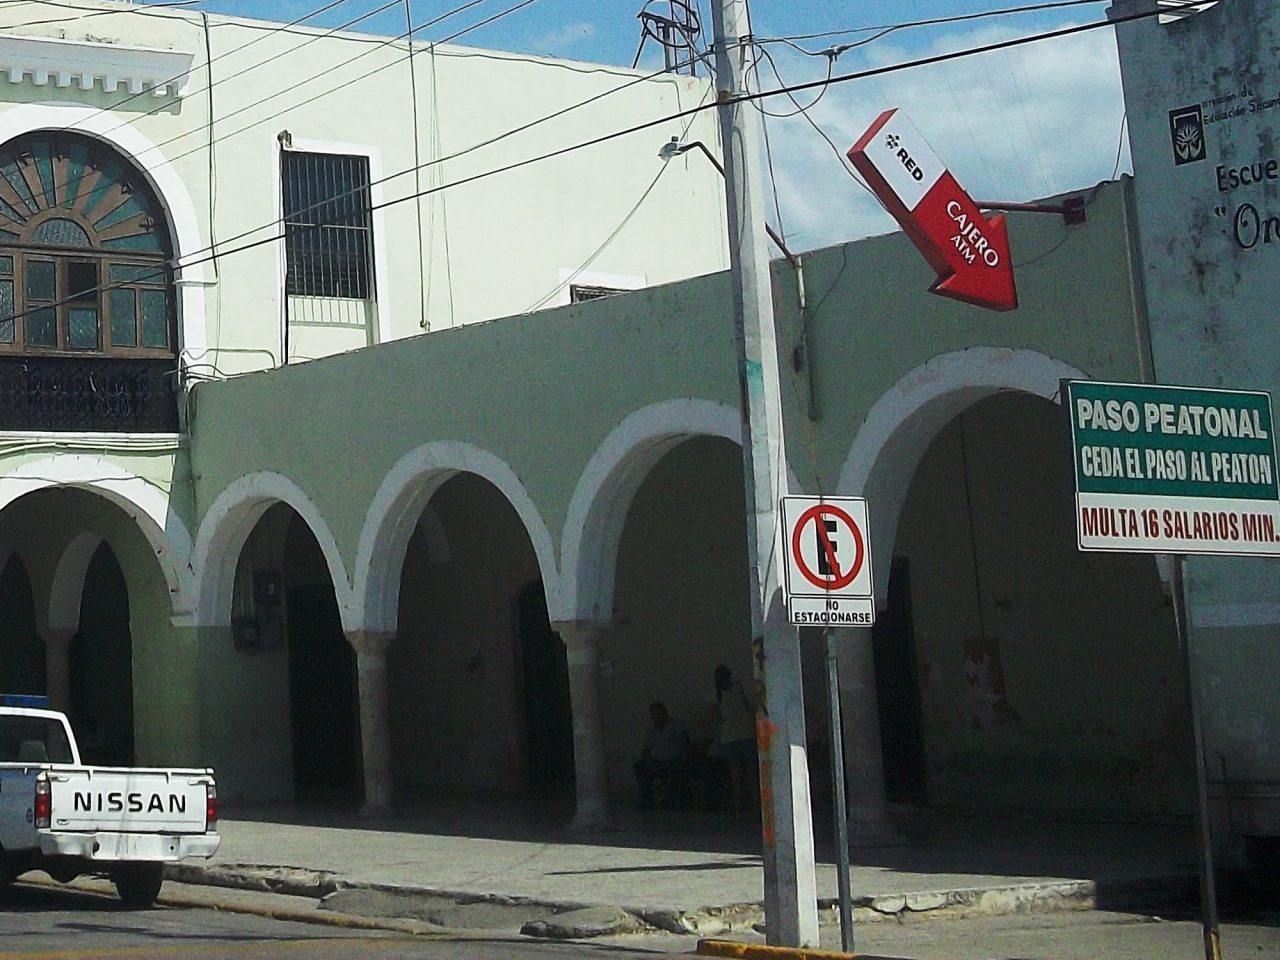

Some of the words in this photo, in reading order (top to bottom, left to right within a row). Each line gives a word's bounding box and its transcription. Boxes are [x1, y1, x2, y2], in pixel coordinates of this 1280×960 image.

[896, 148, 924, 182] RED
[1215, 159, 1278, 192] Escue
[946, 200, 999, 267] CAJERO
[1077, 398, 1140, 432] PASO
[1144, 402, 1268, 439] PEATONAL
[1081, 445, 1123, 477] CEDA
[1125, 447, 1144, 479] EL
[1145, 448, 1187, 480] PASO
[1191, 451, 1210, 481] AL
[1211, 452, 1272, 485] PEATON
[1082, 507, 1139, 538] MULTA
[1141, 508, 1160, 538] 16
[1162, 509, 1240, 541] SALARIOS
[1242, 513, 1280, 543] MIN.
[794, 612, 871, 623] ESTACIONARSE
[826, 601, 839, 611] NO
[74, 792, 186, 813] NISSAN
